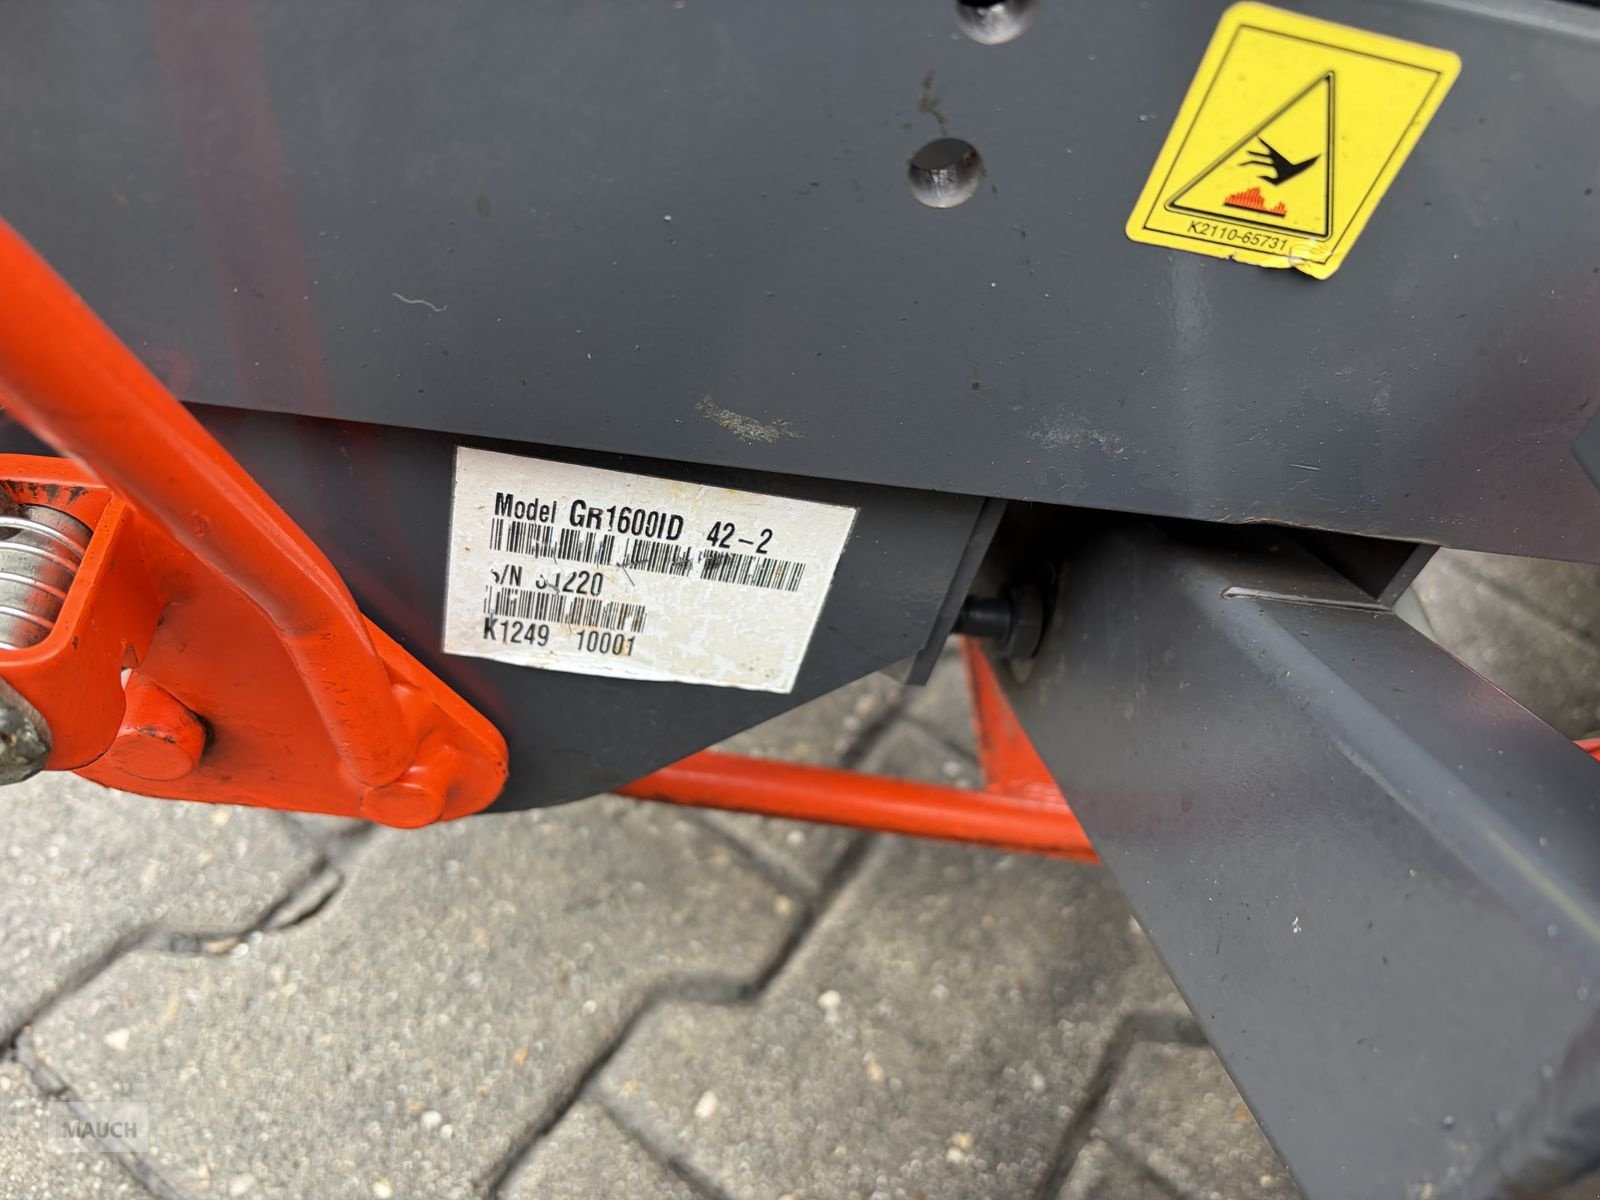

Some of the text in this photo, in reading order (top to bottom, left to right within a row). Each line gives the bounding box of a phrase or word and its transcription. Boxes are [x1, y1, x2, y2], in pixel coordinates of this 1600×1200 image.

[1187, 221, 1288, 251] K2110-65731
[494, 492, 774, 554] Model GR1600ID 42-2
[483, 617, 636, 657] K1249 10001
